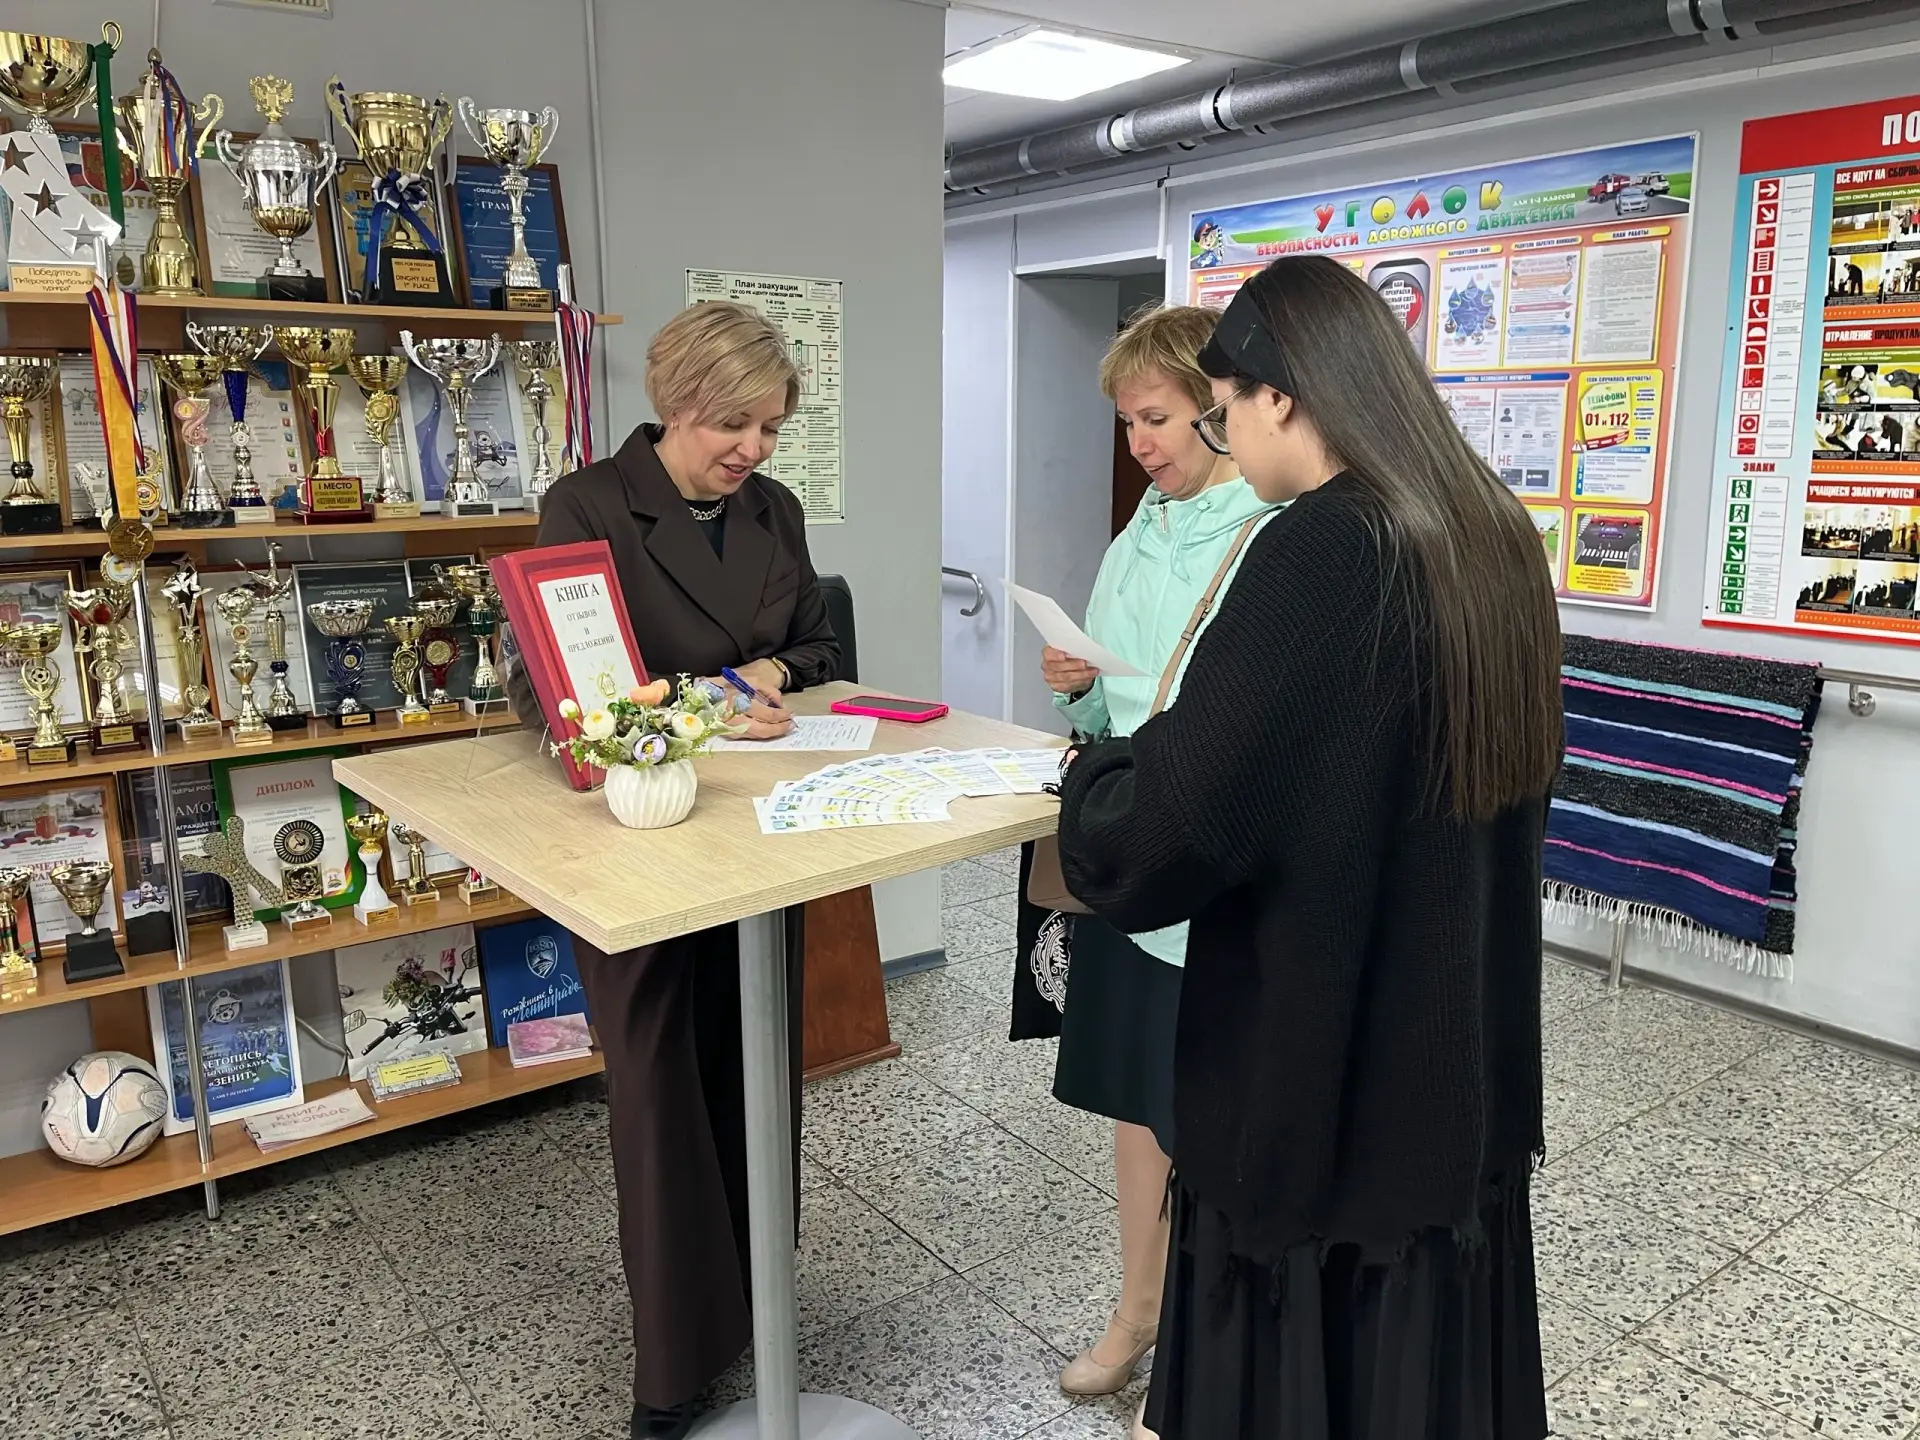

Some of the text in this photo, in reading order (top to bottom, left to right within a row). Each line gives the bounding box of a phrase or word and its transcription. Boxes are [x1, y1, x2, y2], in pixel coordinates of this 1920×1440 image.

[1836, 172, 1852, 184] ВСЕ
[1852, 169, 1874, 183] ИДУТ
[1875, 168, 1886, 180] НА
[1314, 179, 1504, 233] УГОЛОК
[1256, 203, 1576, 256] БЕЗОПАСНОСТИ ДОРОЖНОГО ДВИЖЕНИЯ
[28, 267, 81, 277] Победитель
[735, 279, 799, 291] План эвакуации
[1825, 330, 1873, 342] ОТРАВЛЕНИЕ
[1588, 391, 1627, 405] ТЕЛЕФОНЫ
[1585, 413, 1600, 427] 01
[1609, 412, 1630, 427] 112
[1498, 455, 1512, 467] НЕ
[1743, 462, 1776, 473] ЗНАКИ
[323, 482, 352, 490] МЕСТО
[1809, 485, 1914, 499] УЧАЩИЕСЯ ЭВАКУИРУЮТСЯ
[555, 583, 600, 602] КНИГА
[566, 608, 598, 622] ОТЗЫВОВ
[568, 634, 615, 653] ПРЕДЛОЖЕНИЙ
[256, 779, 315, 797] ДИПЛОМ
[208, 1071, 257, 1087] «ЗЕНИТ»
[275, 1104, 327, 1121] КНИГА
